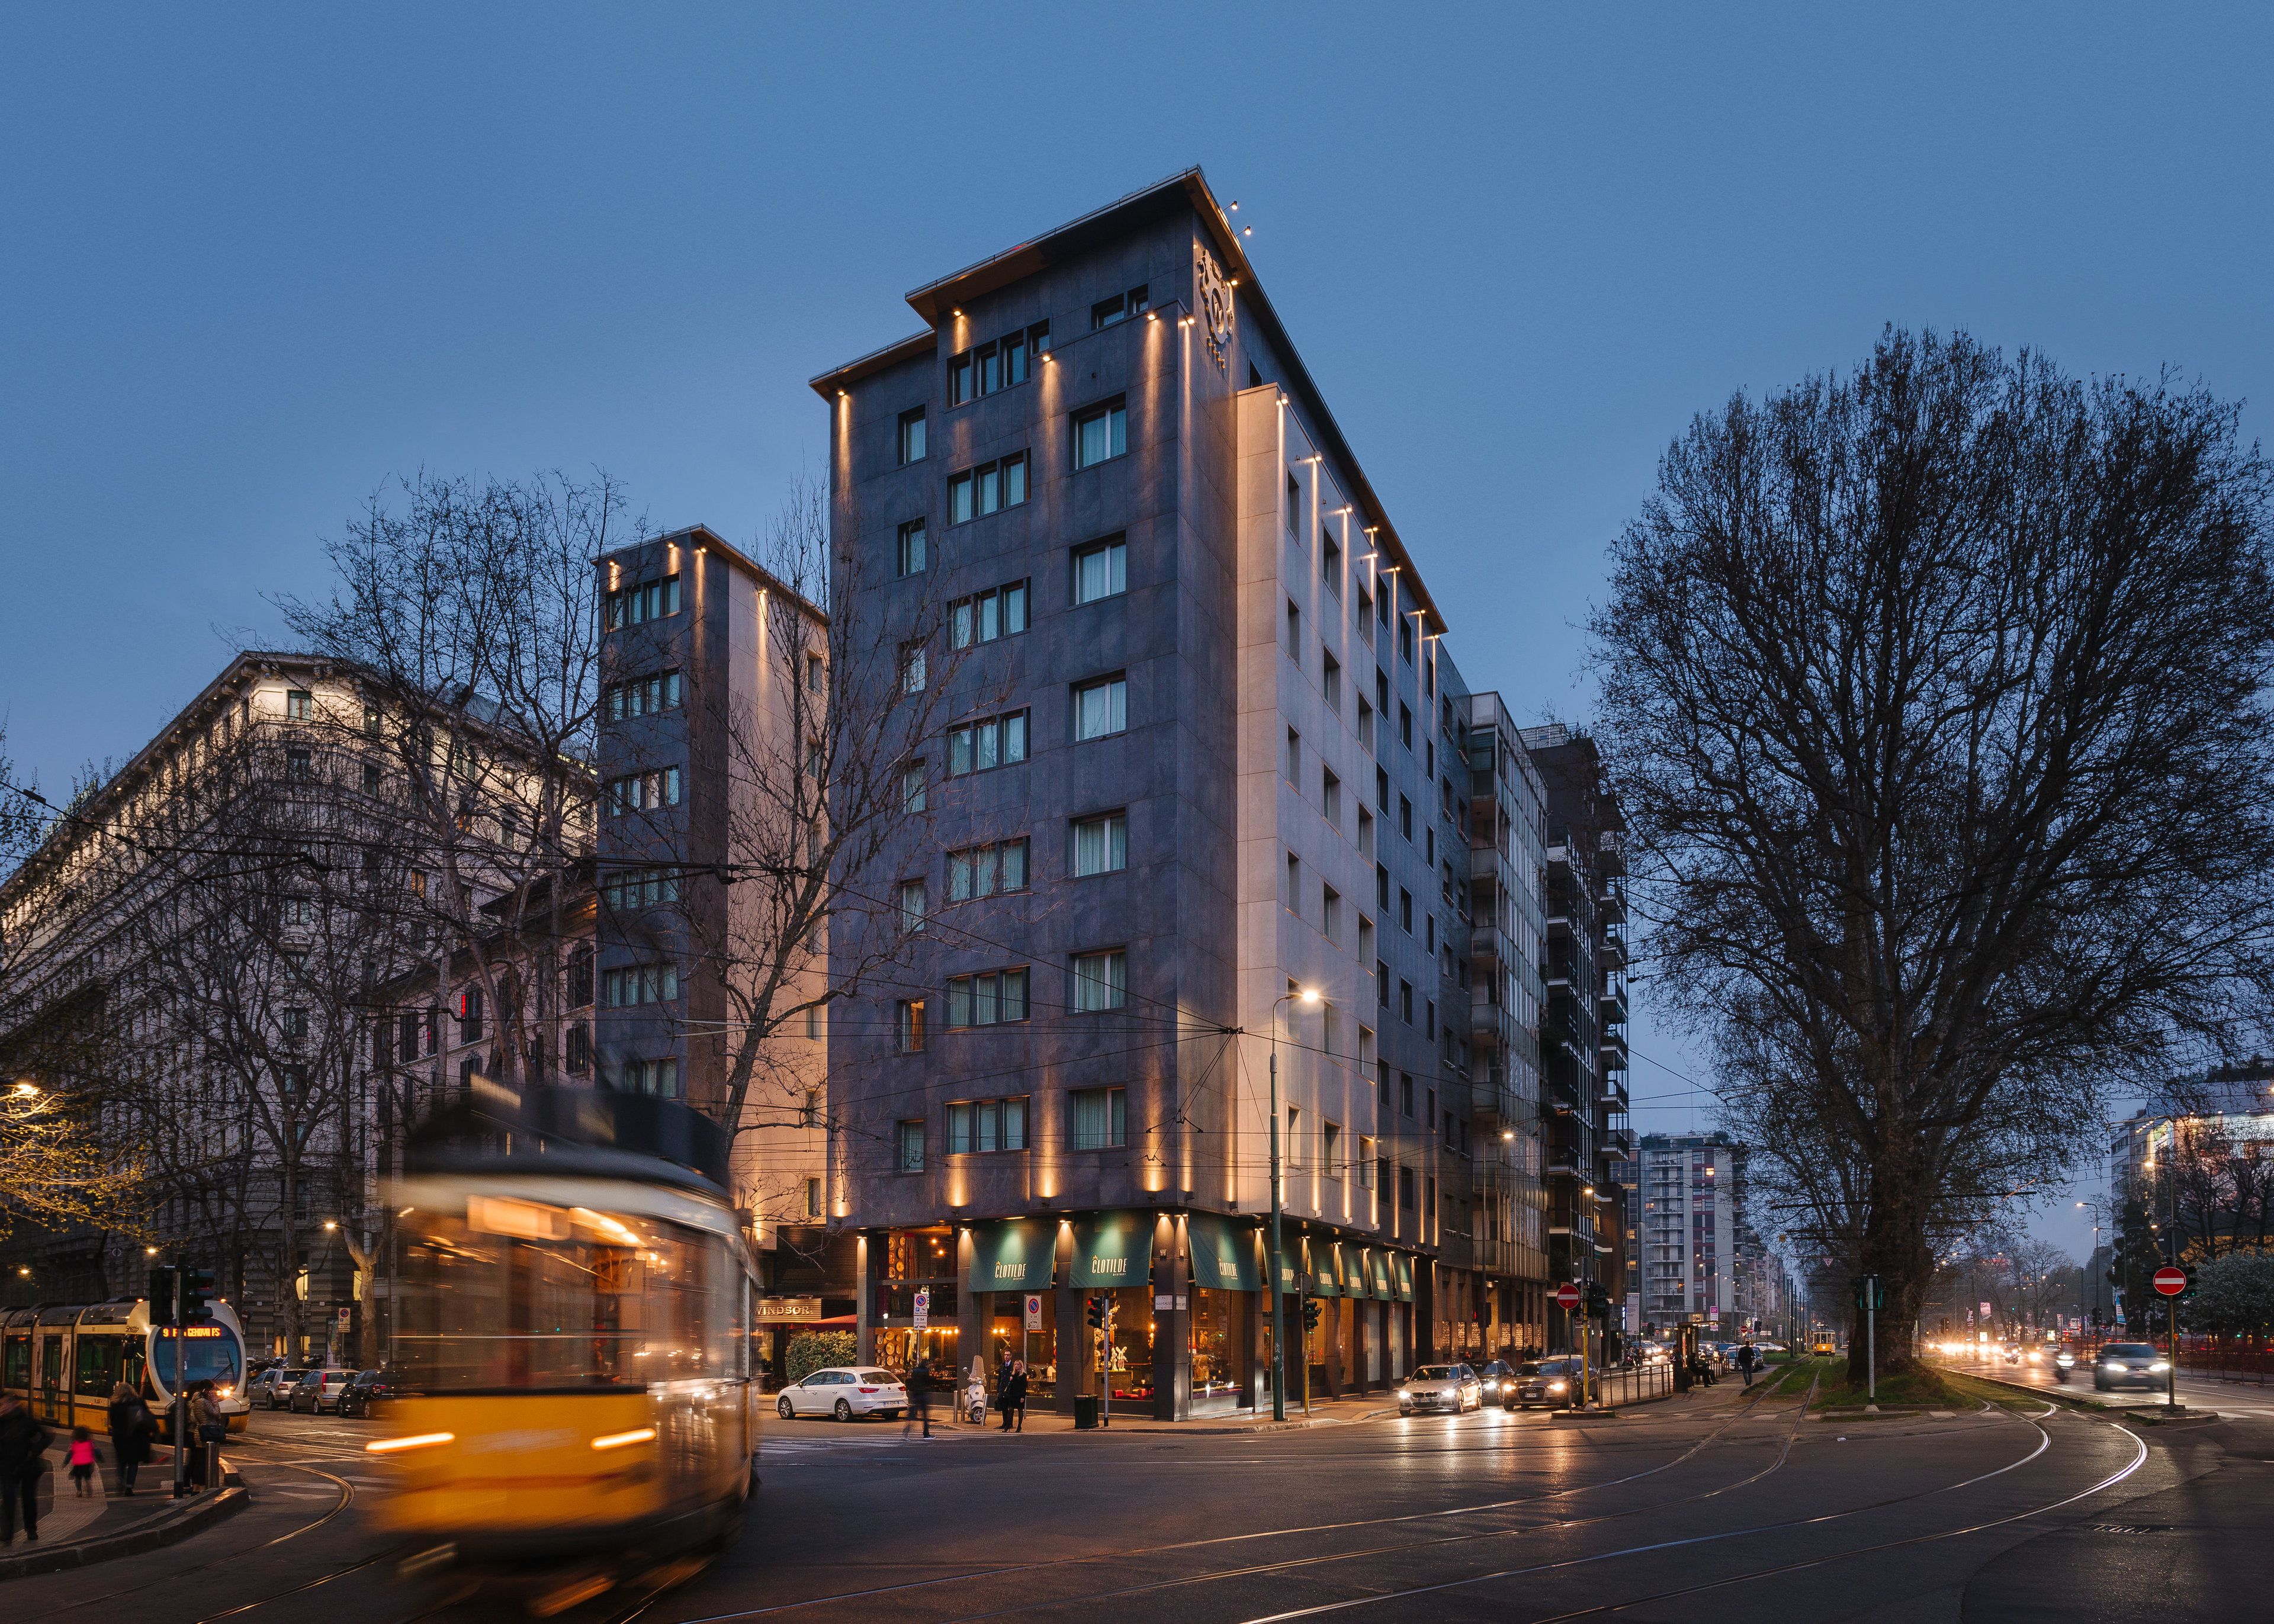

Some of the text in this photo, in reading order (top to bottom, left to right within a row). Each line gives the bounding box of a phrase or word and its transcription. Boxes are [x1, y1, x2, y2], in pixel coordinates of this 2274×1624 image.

[995, 1263, 1026, 1278] CLOTILDE
[1092, 1258, 1128, 1274] CLOTILDE
[1219, 1262, 1238, 1277] CLOTILDE
[163, 1328, 169, 1337] 9
[187, 1328, 210, 1336] GENOVA
[211, 1328, 220, 1336] FS
